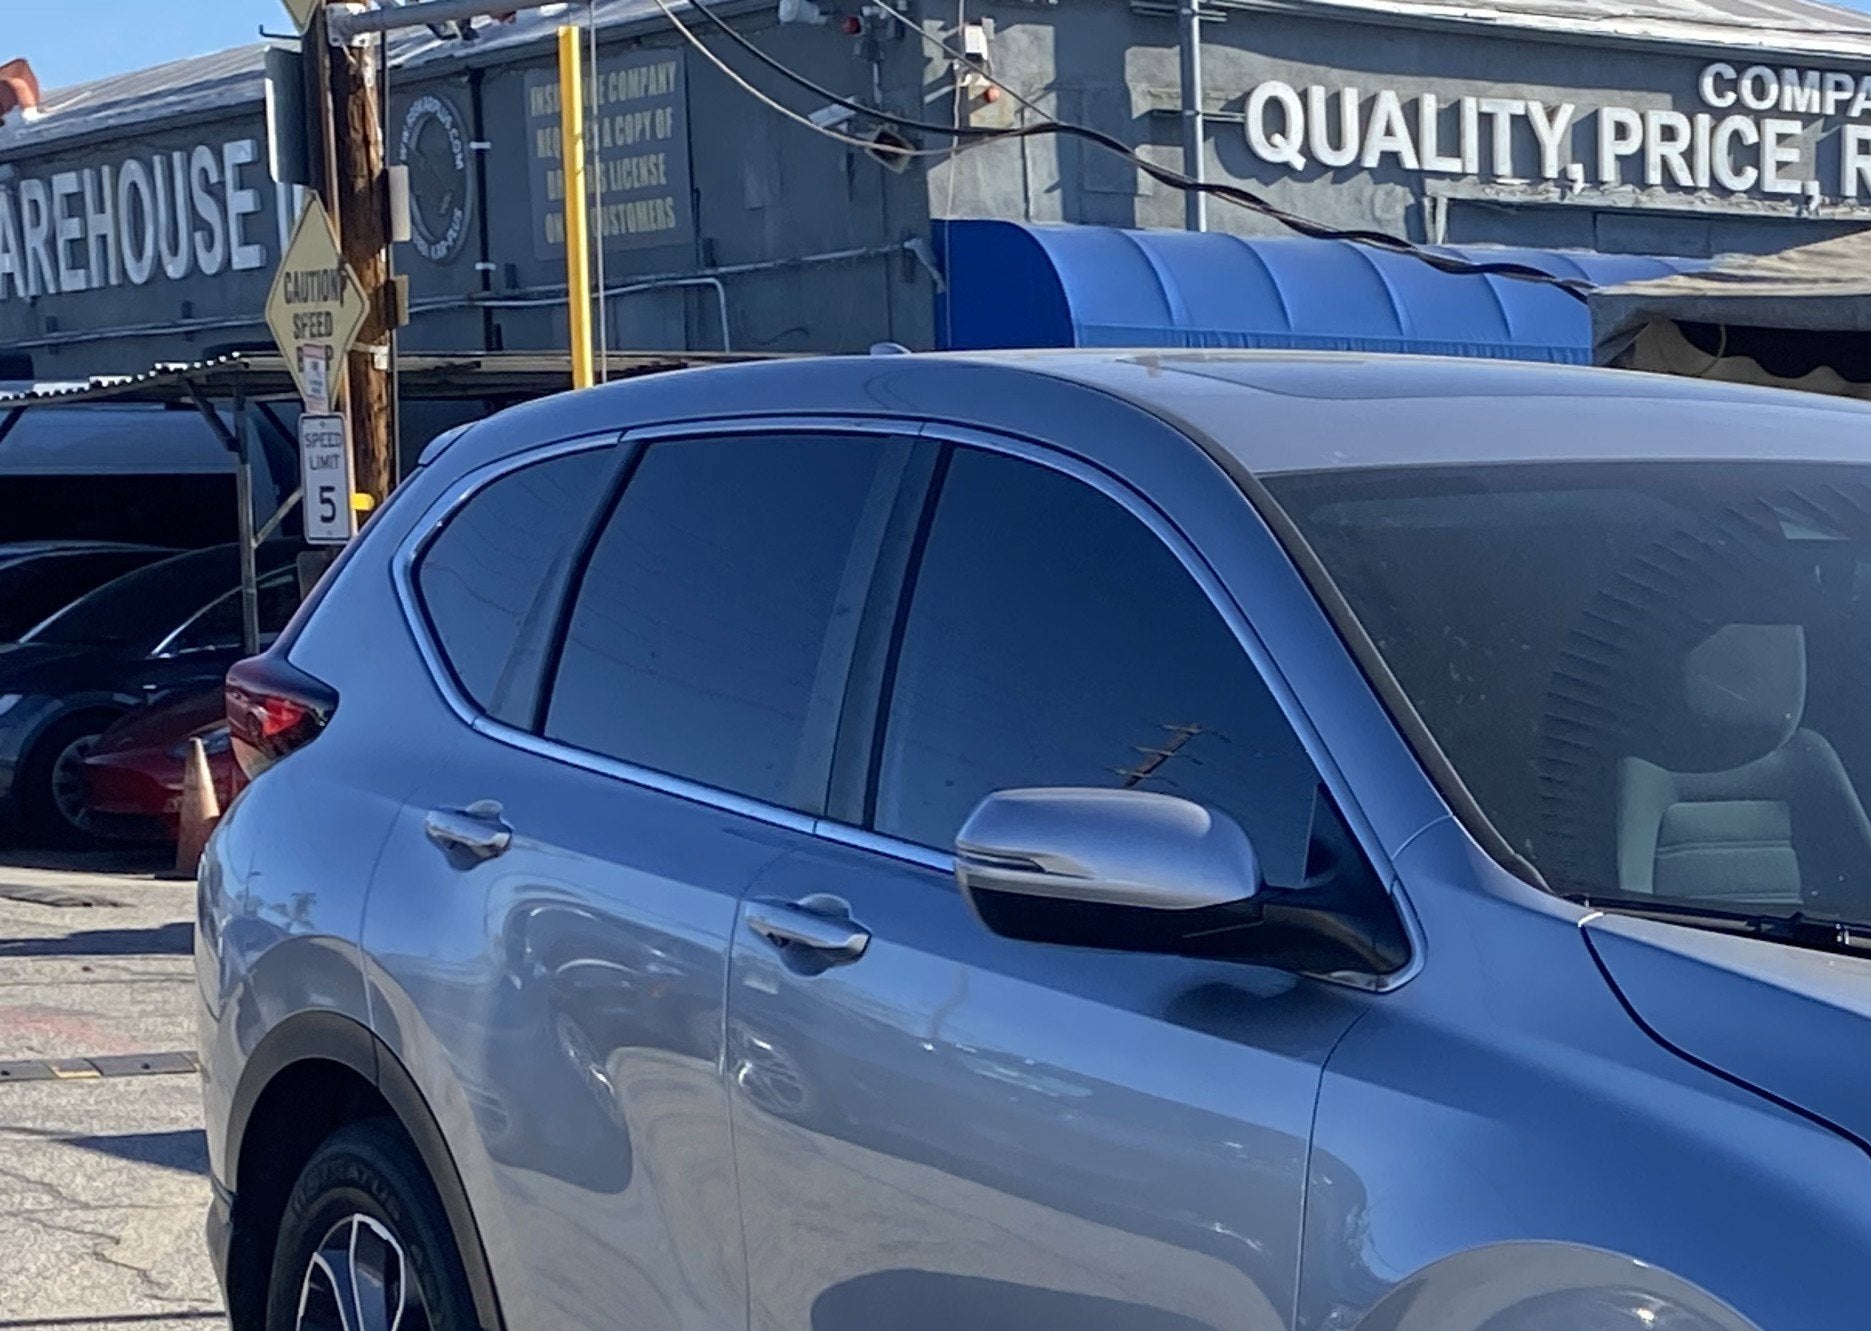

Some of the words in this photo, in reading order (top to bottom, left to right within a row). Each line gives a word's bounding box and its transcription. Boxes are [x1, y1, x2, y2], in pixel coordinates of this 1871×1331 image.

[608, 60, 677, 103] COMPANY
[602, 117, 614, 147] A
[614, 110, 653, 146] COPY
[655, 106, 673, 140] OF
[1244, 80, 1584, 194] QUALITY,
[1598, 106, 1820, 212] PRICE,
[608, 152, 667, 191] LICENSE
[590, 196, 676, 237] CUSTOMERS
[284, 269, 343, 304] CAUTION
[293, 310, 333, 339] SPEED
[304, 431, 341, 449] SPEED
[309, 453, 339, 471] LIMIT
[319, 485, 336, 523] 5
